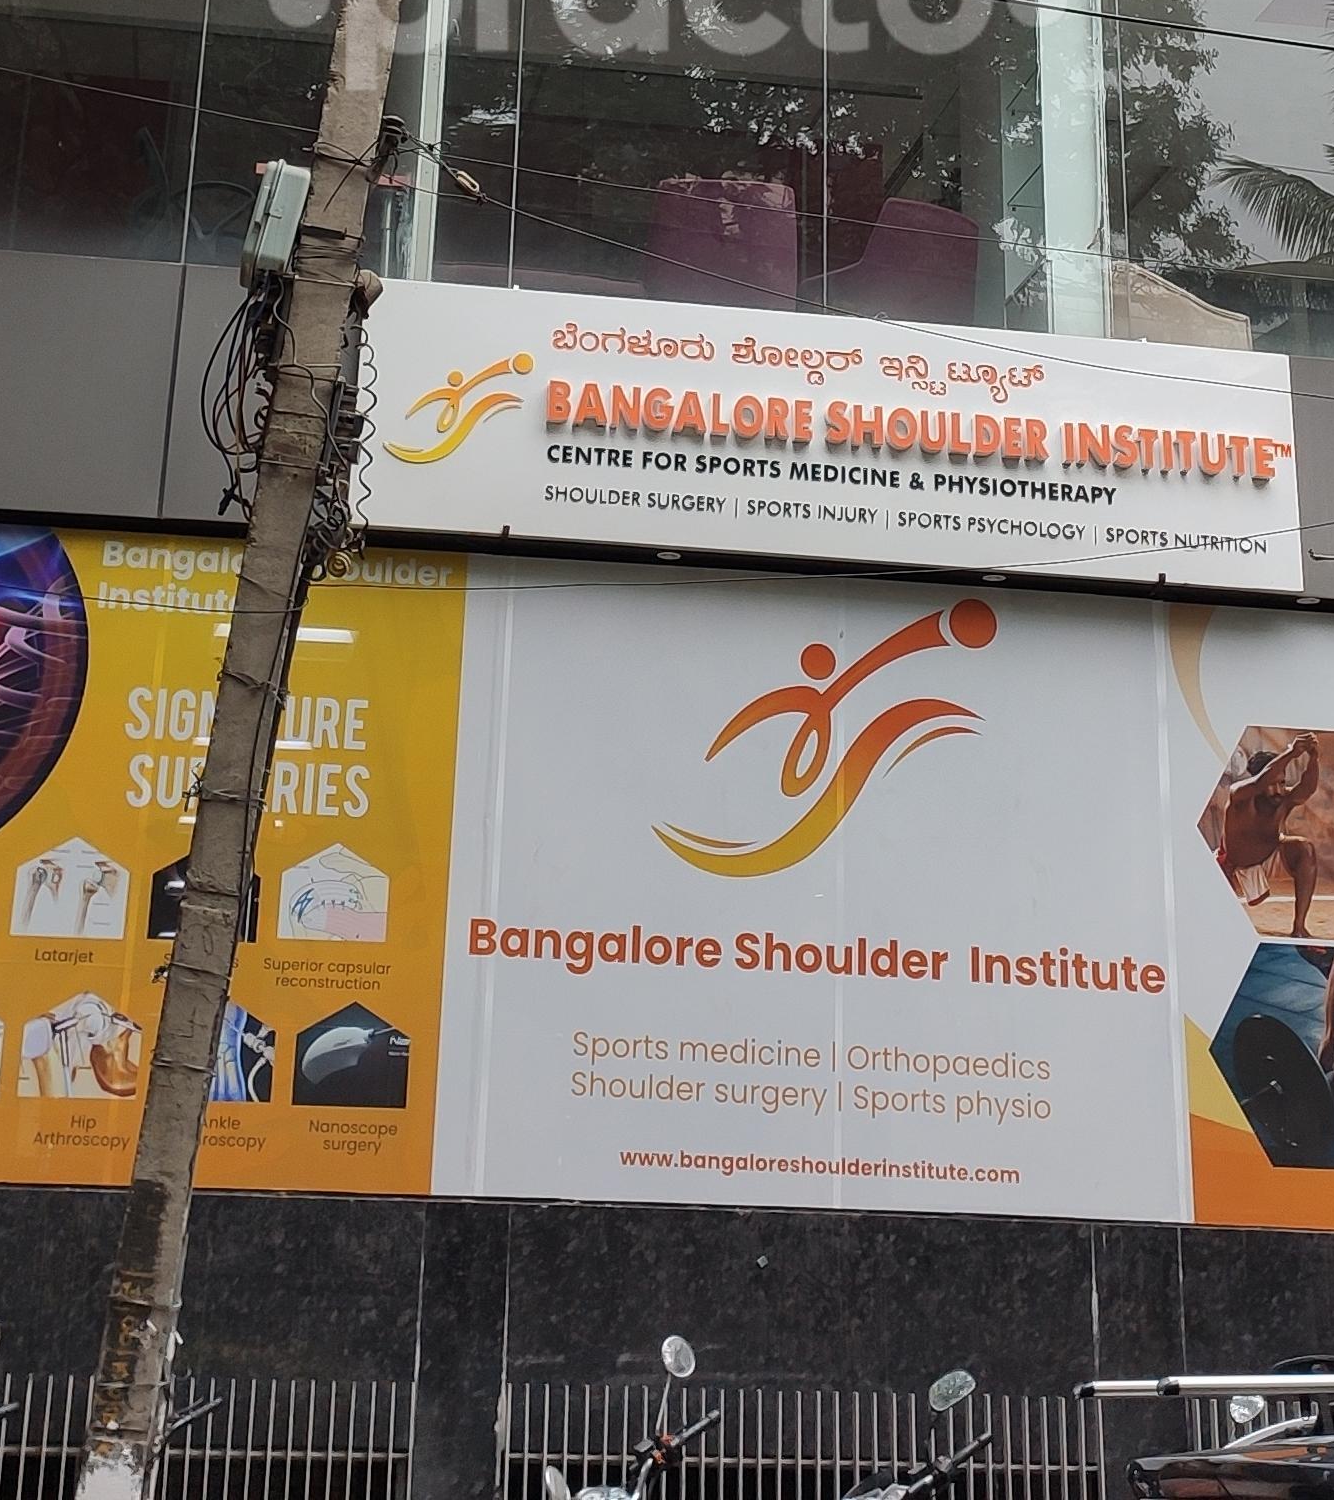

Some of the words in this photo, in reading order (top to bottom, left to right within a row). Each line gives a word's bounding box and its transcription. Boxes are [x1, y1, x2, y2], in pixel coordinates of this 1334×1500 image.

[550, 322, 715, 363] ಬೆಂಗಳೂರು
[545, 380, 814, 444] BANGALORE
[824, 400, 1049, 466] SHOULDER
[547, 444, 633, 468] CENTRE
[642, 451, 687, 472] FOR
[695, 454, 782, 479] SPORTS
[789, 463, 901, 489] MEDICINE
[909, 472, 925, 491] &
[934, 473, 1117, 506] PHYSIOTHERAPY
[545, 485, 641, 508] SHOULDER
[647, 492, 728, 514] SURGERY
[746, 499, 812, 520] SPORTS
[817, 503, 879, 525] INJURY
[897, 510, 962, 531] SPORTS
[967, 516, 1086, 541] PSYCHOLOGY
[1105, 526, 1169, 548] SPORTS
[1174, 533, 1268, 555] NUTRITION
[101, 540, 245, 581] Bangal
[312, 555, 452, 587] oulder
[124, 686, 369, 750] SIGNURE
[125, 753, 371, 818] SURIES
[34, 948, 94, 966] Latarjet
[263, 956, 325, 975] Superior
[327, 958, 392, 978] capsular
[467, 917, 723, 975] Bangalore
[734, 931, 950, 981] Shoulder
[970, 946, 1168, 995] Institute
[275, 975, 381, 993] reconstruction
[572, 1031, 669, 1066] Sports
[678, 1037, 821, 1069] medicine
[846, 1044, 1052, 1084] Orthopaedics
[570, 1072, 706, 1103] Shoulder
[714, 1083, 828, 1116] surgery
[853, 1087, 947, 1120] Sports
[956, 1092, 1052, 1126] physio
[33, 1131, 130, 1151] Arthroscopy
[70, 1114, 97, 1133] Hip
[199, 1134, 266, 1152] roscopy
[309, 1118, 398, 1137] Nanoscope
[323, 1138, 382, 1156] surgery
[619, 1149, 1021, 1185] www.bangaloreshoulderinstitute.com
